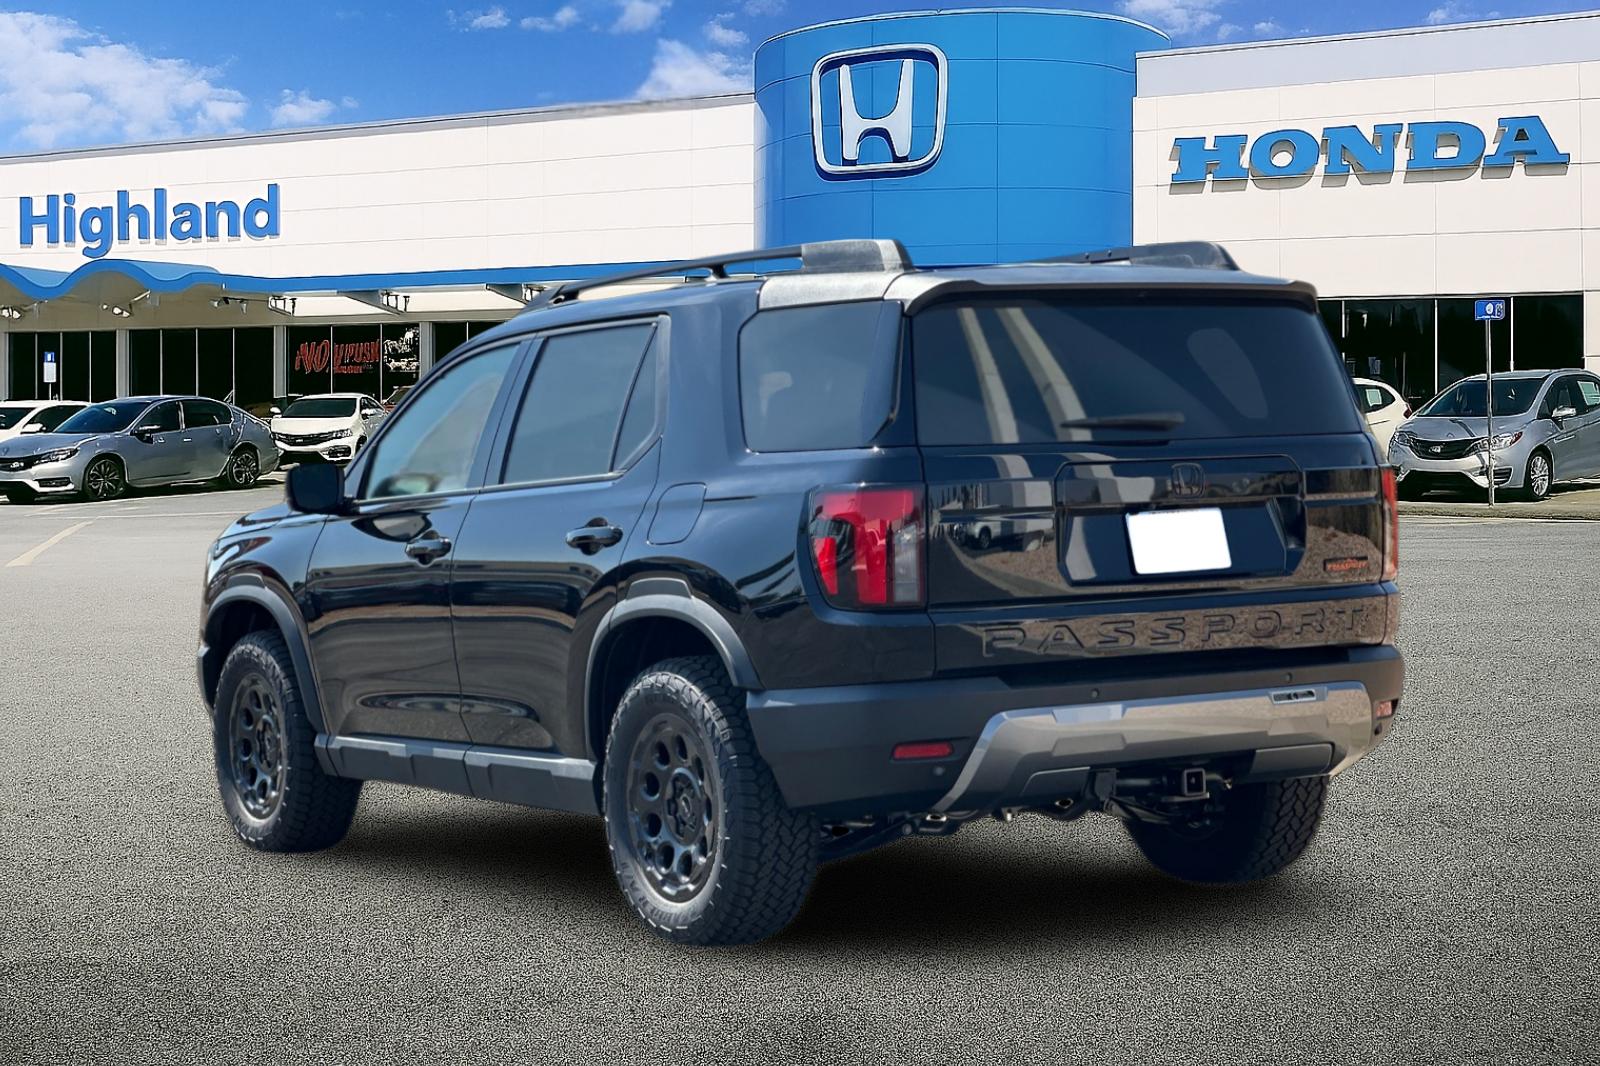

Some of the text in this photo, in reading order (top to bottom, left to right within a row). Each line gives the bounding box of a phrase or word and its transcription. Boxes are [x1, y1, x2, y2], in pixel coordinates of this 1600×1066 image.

[1170, 115, 1571, 184] HONDA
[19, 184, 280, 258] Highland
[982, 606, 1366, 657] PASSPORT
